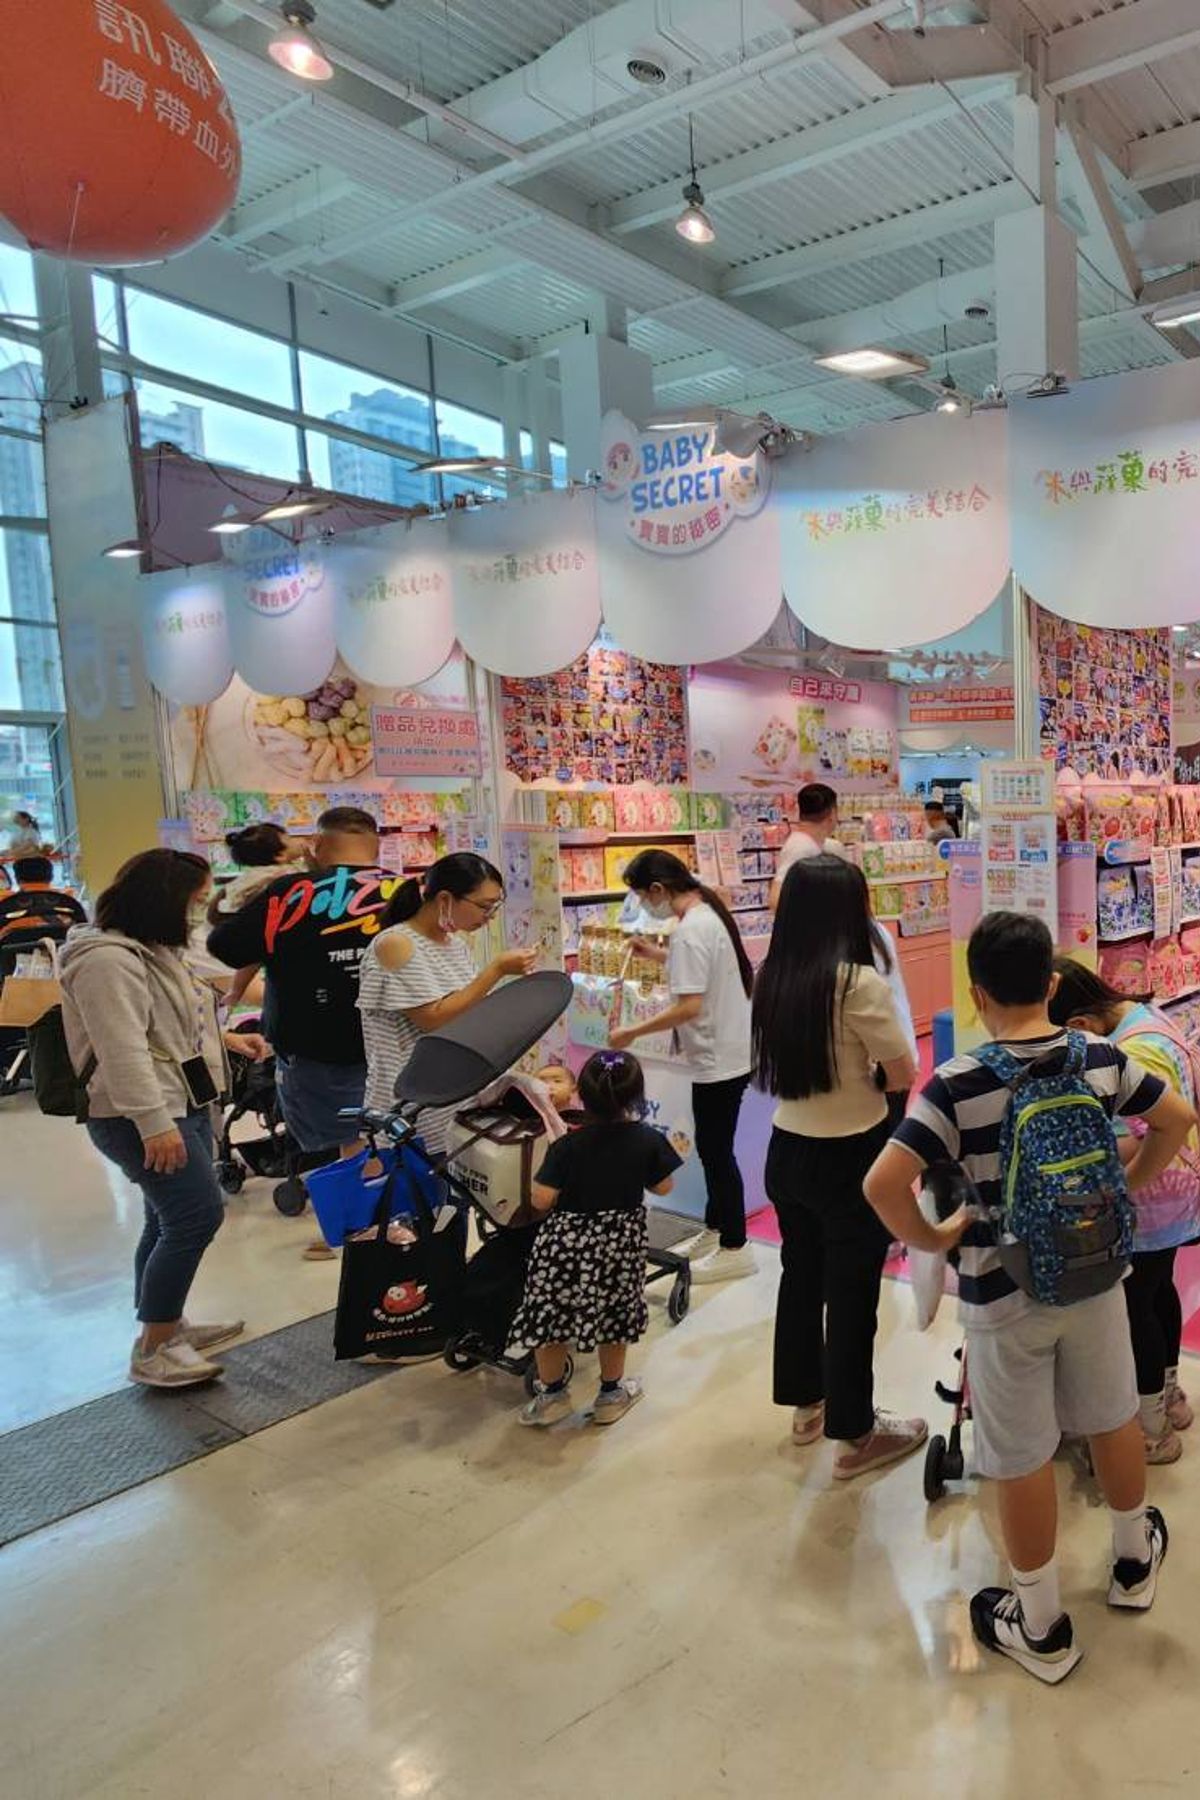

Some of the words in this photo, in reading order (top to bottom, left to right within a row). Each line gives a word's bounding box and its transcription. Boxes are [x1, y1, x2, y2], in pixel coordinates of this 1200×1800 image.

[641, 431, 709, 475] BABY
[631, 466, 724, 513] SECRET
[328, 949, 354, 962] THE
